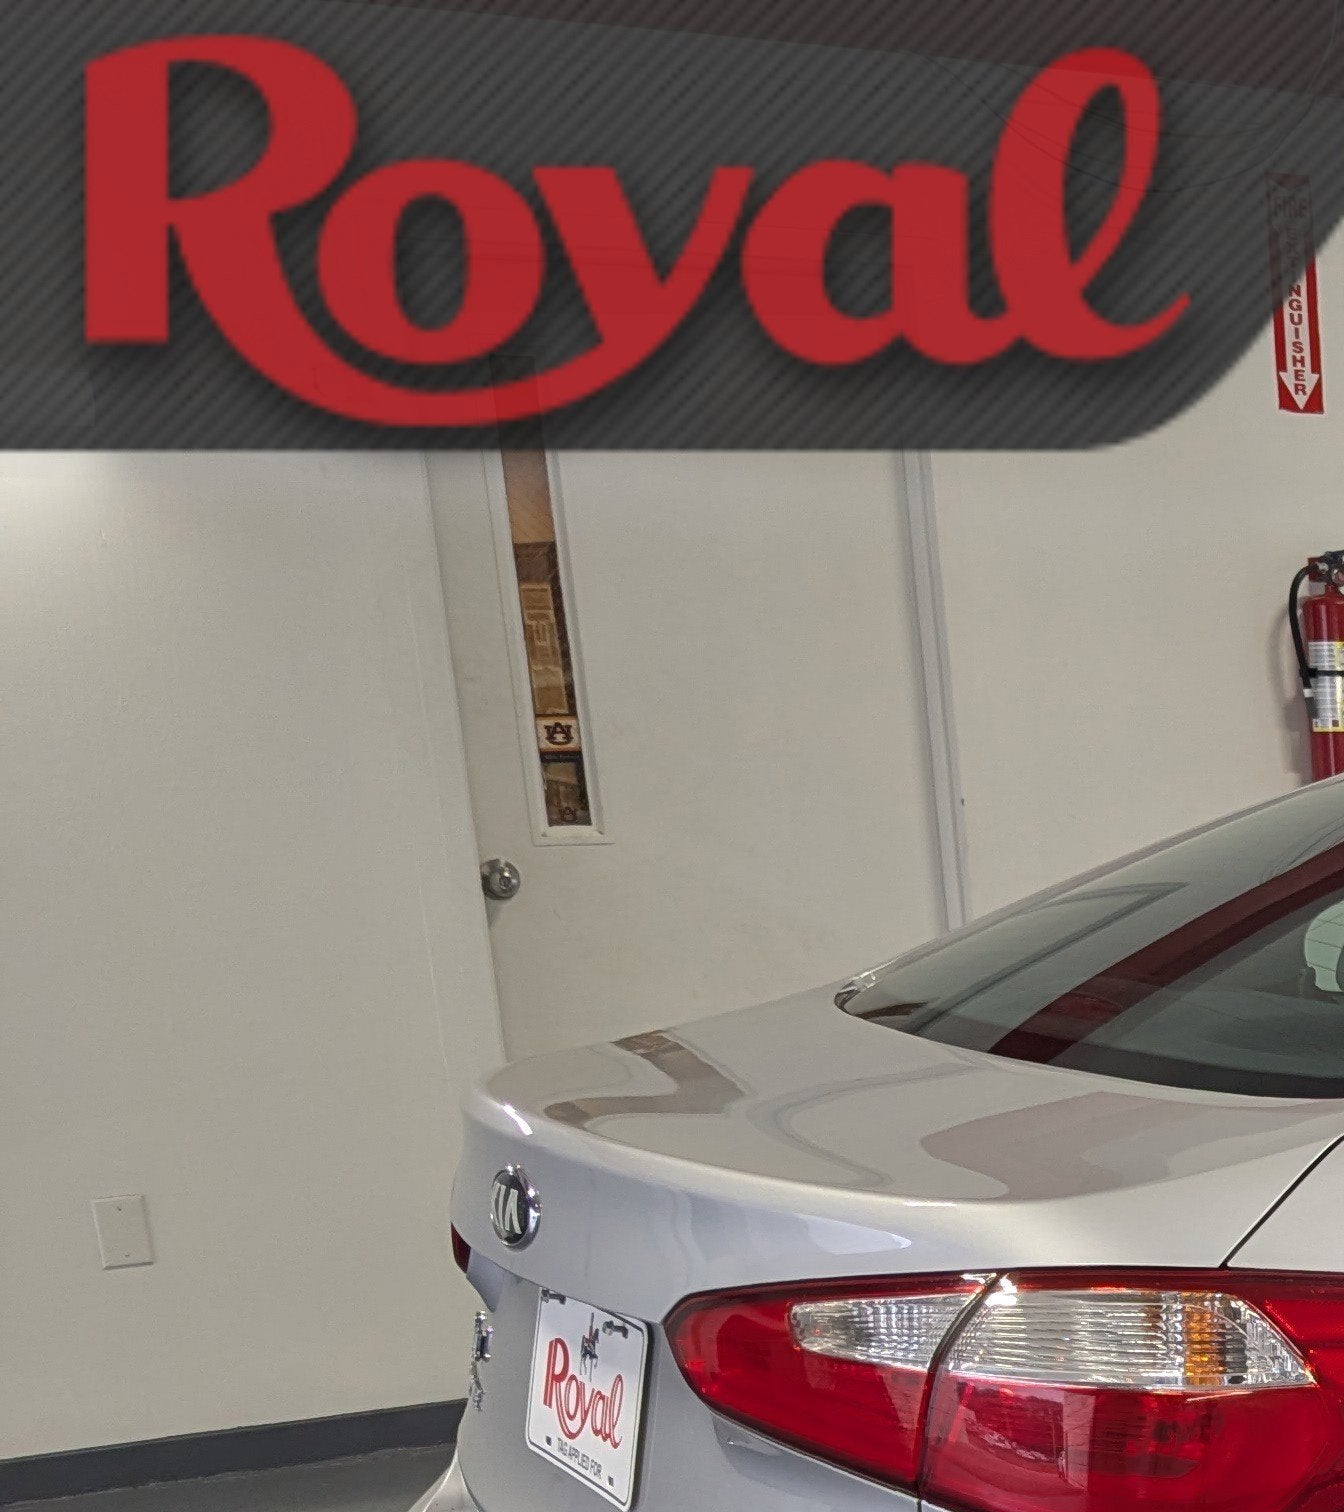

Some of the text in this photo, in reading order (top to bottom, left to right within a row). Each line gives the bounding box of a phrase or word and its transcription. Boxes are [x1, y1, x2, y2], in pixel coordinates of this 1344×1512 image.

[543, 1337, 624, 1449] Royal
[557, 1437, 602, 1480] TAG APPLIED FOR
